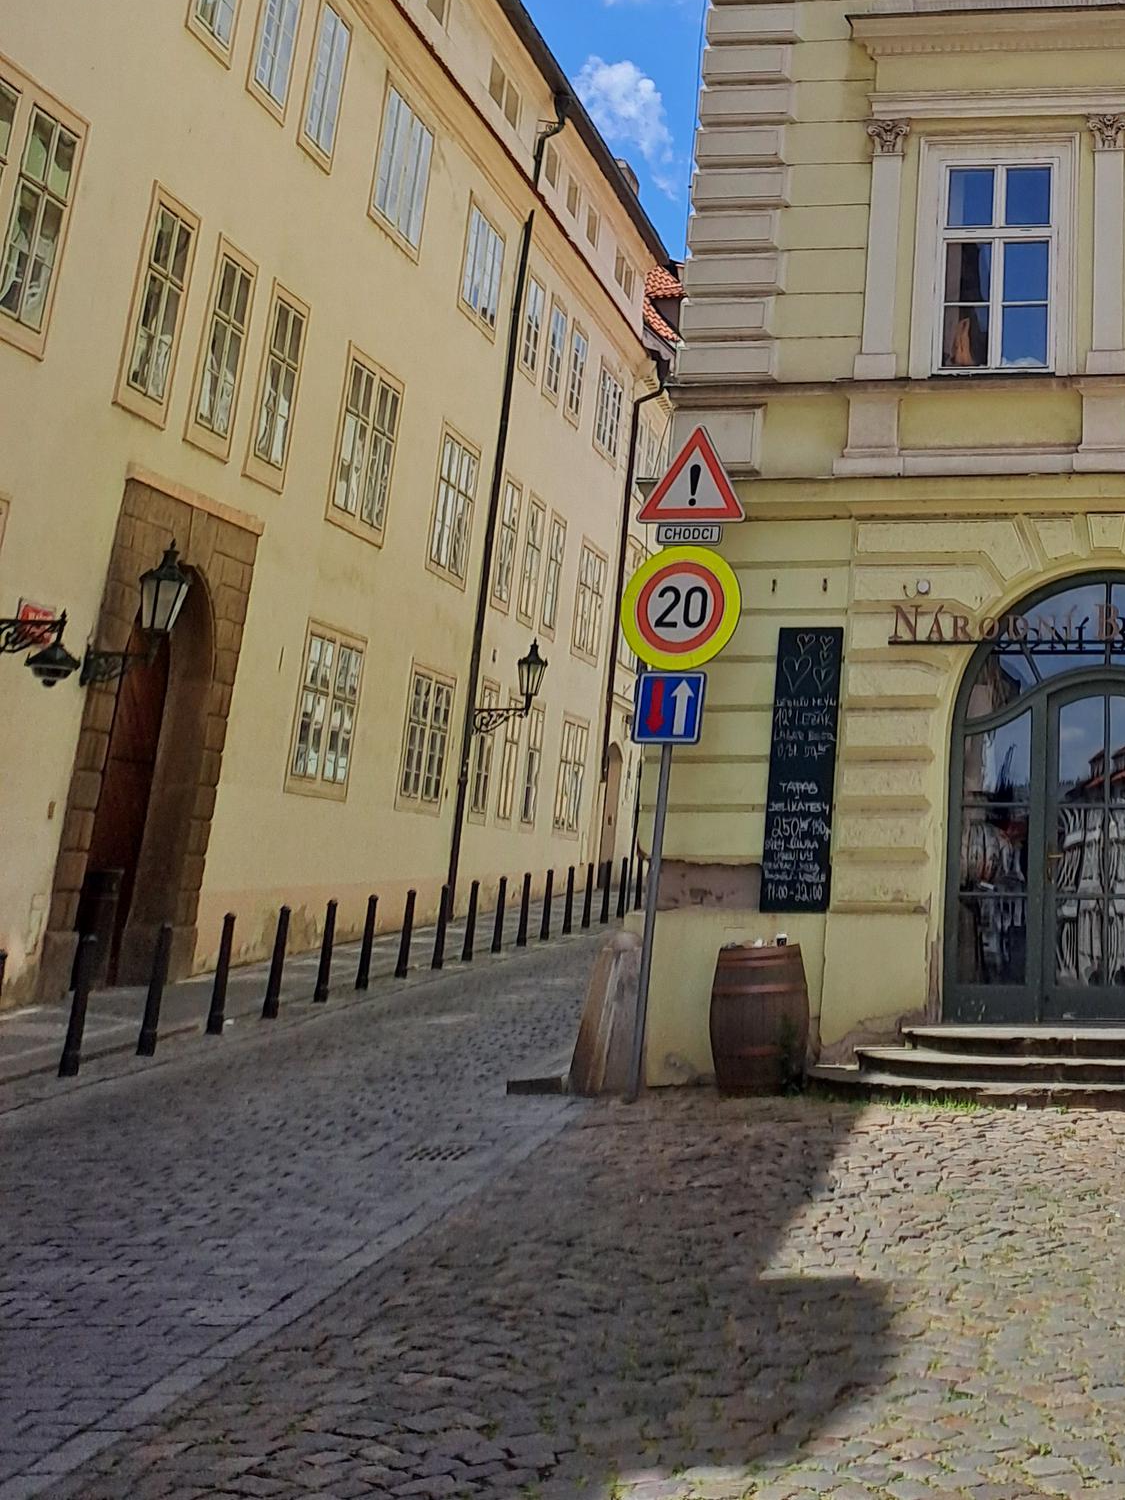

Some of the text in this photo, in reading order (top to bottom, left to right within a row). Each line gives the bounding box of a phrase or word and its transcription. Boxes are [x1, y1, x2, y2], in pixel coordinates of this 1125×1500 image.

[664, 527, 714, 541] CHODCI
[653, 585, 708, 629] 20
[889, 604, 1077, 642] NÁRODNÍ
